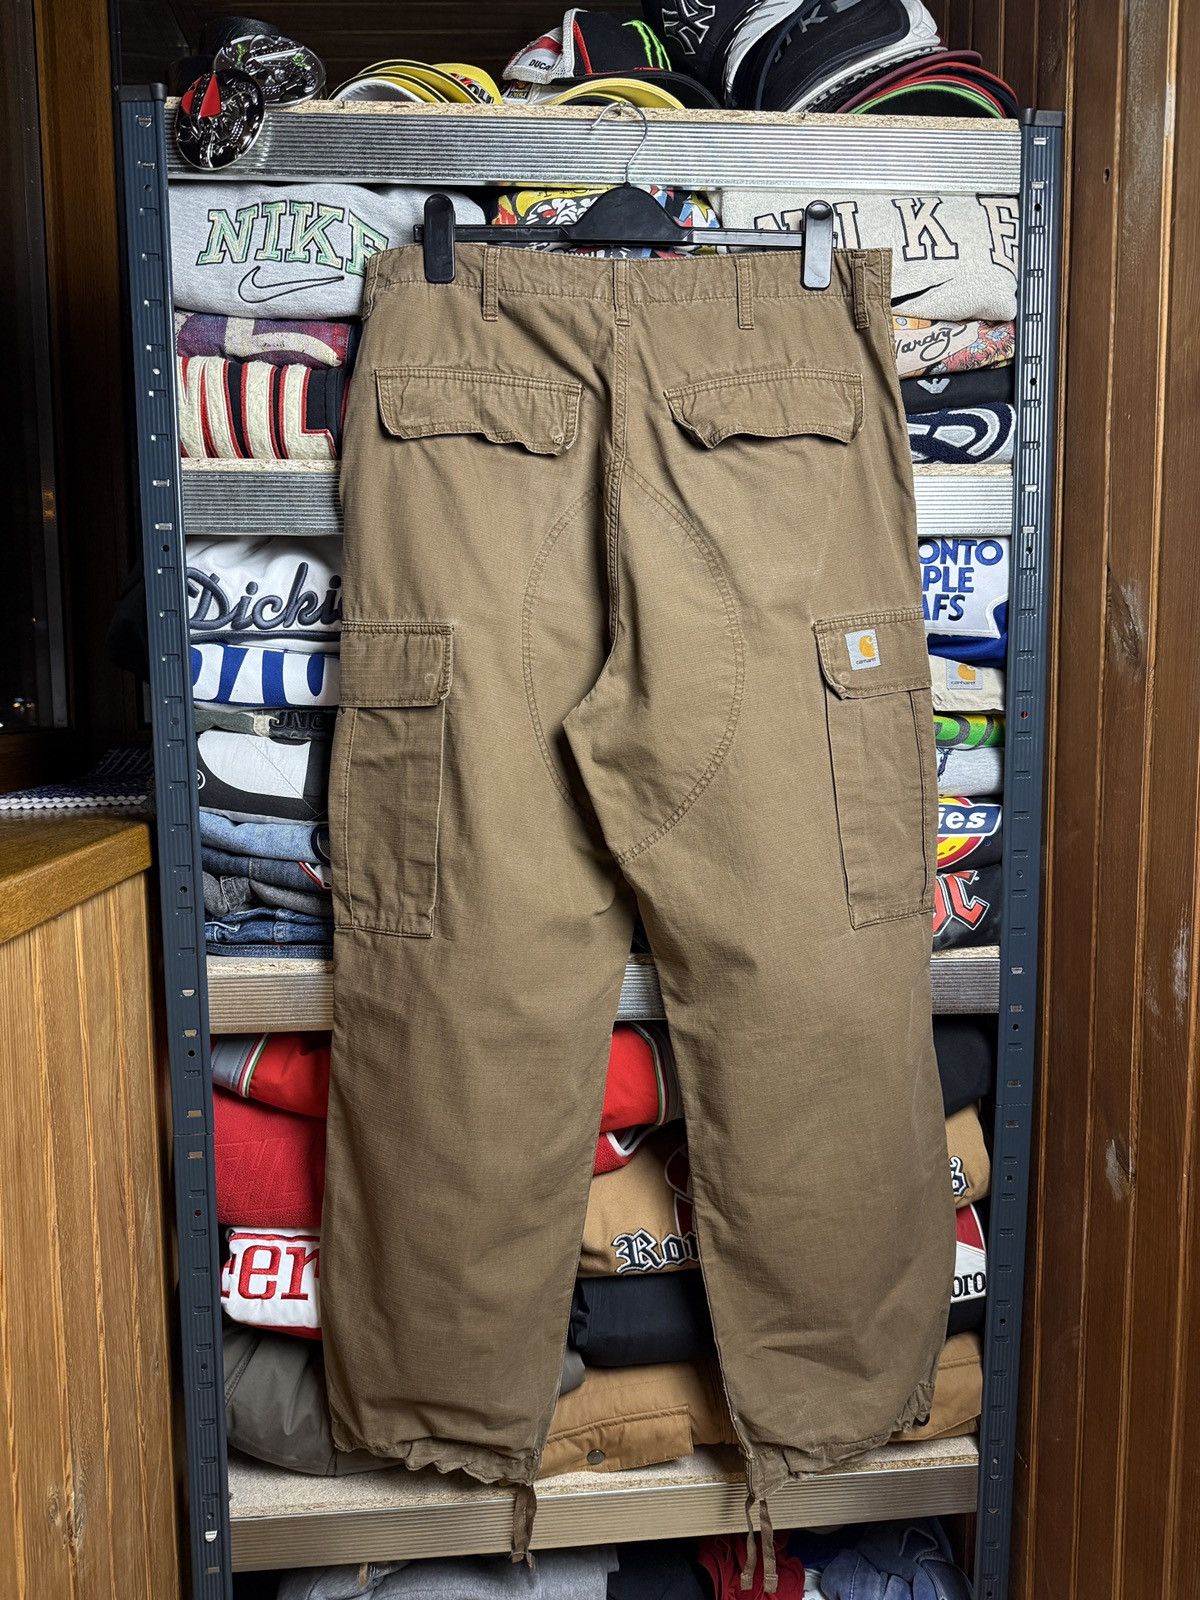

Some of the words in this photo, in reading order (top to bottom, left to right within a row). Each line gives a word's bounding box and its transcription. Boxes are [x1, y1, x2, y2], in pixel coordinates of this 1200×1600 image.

[528, 58, 556, 72] DUCA
[754, 193, 1018, 268] IKE
[187, 561, 342, 631] Dicki
[922, 565, 975, 593] PLE
[221, 1244, 320, 1301] er
